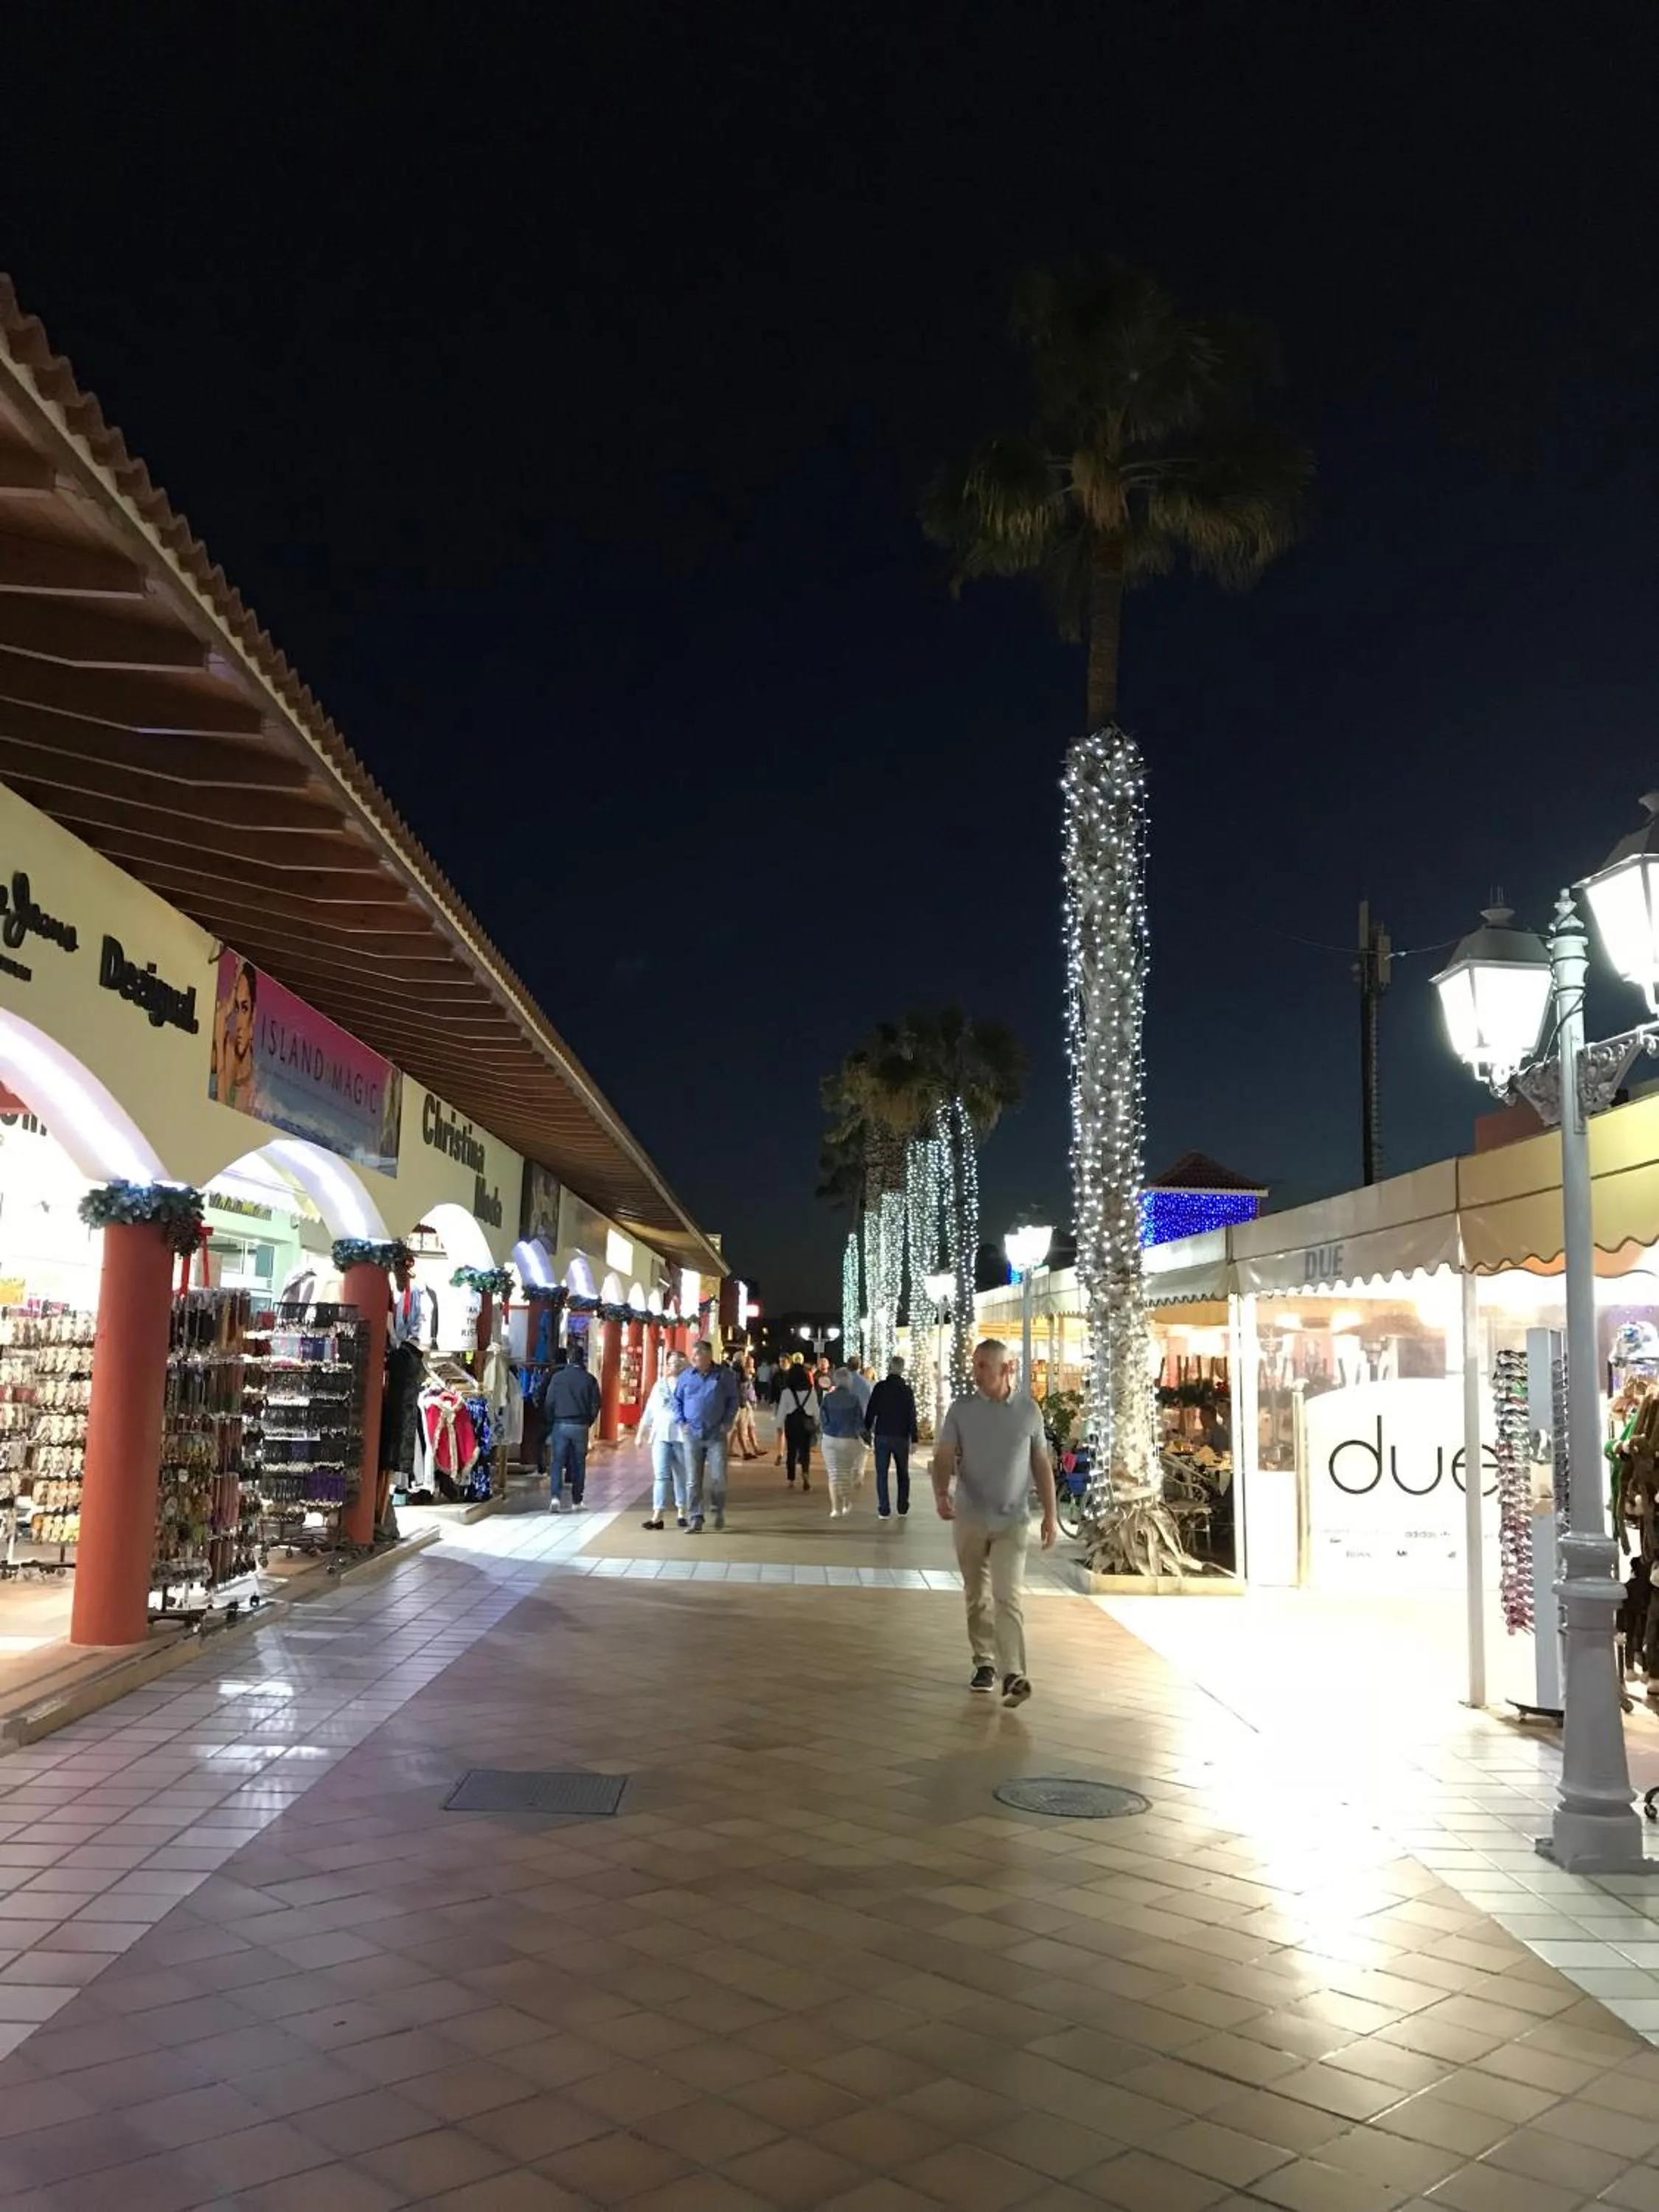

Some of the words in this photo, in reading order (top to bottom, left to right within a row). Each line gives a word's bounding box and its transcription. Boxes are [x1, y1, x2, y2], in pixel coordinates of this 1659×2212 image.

[260, 1013, 324, 1081] ISLAND
[332, 1062, 378, 1115] MAGIC
[422, 1093, 486, 1175] Christina
[1304, 1244, 1343, 1281] DUE
[1328, 1414, 1500, 1497] due
